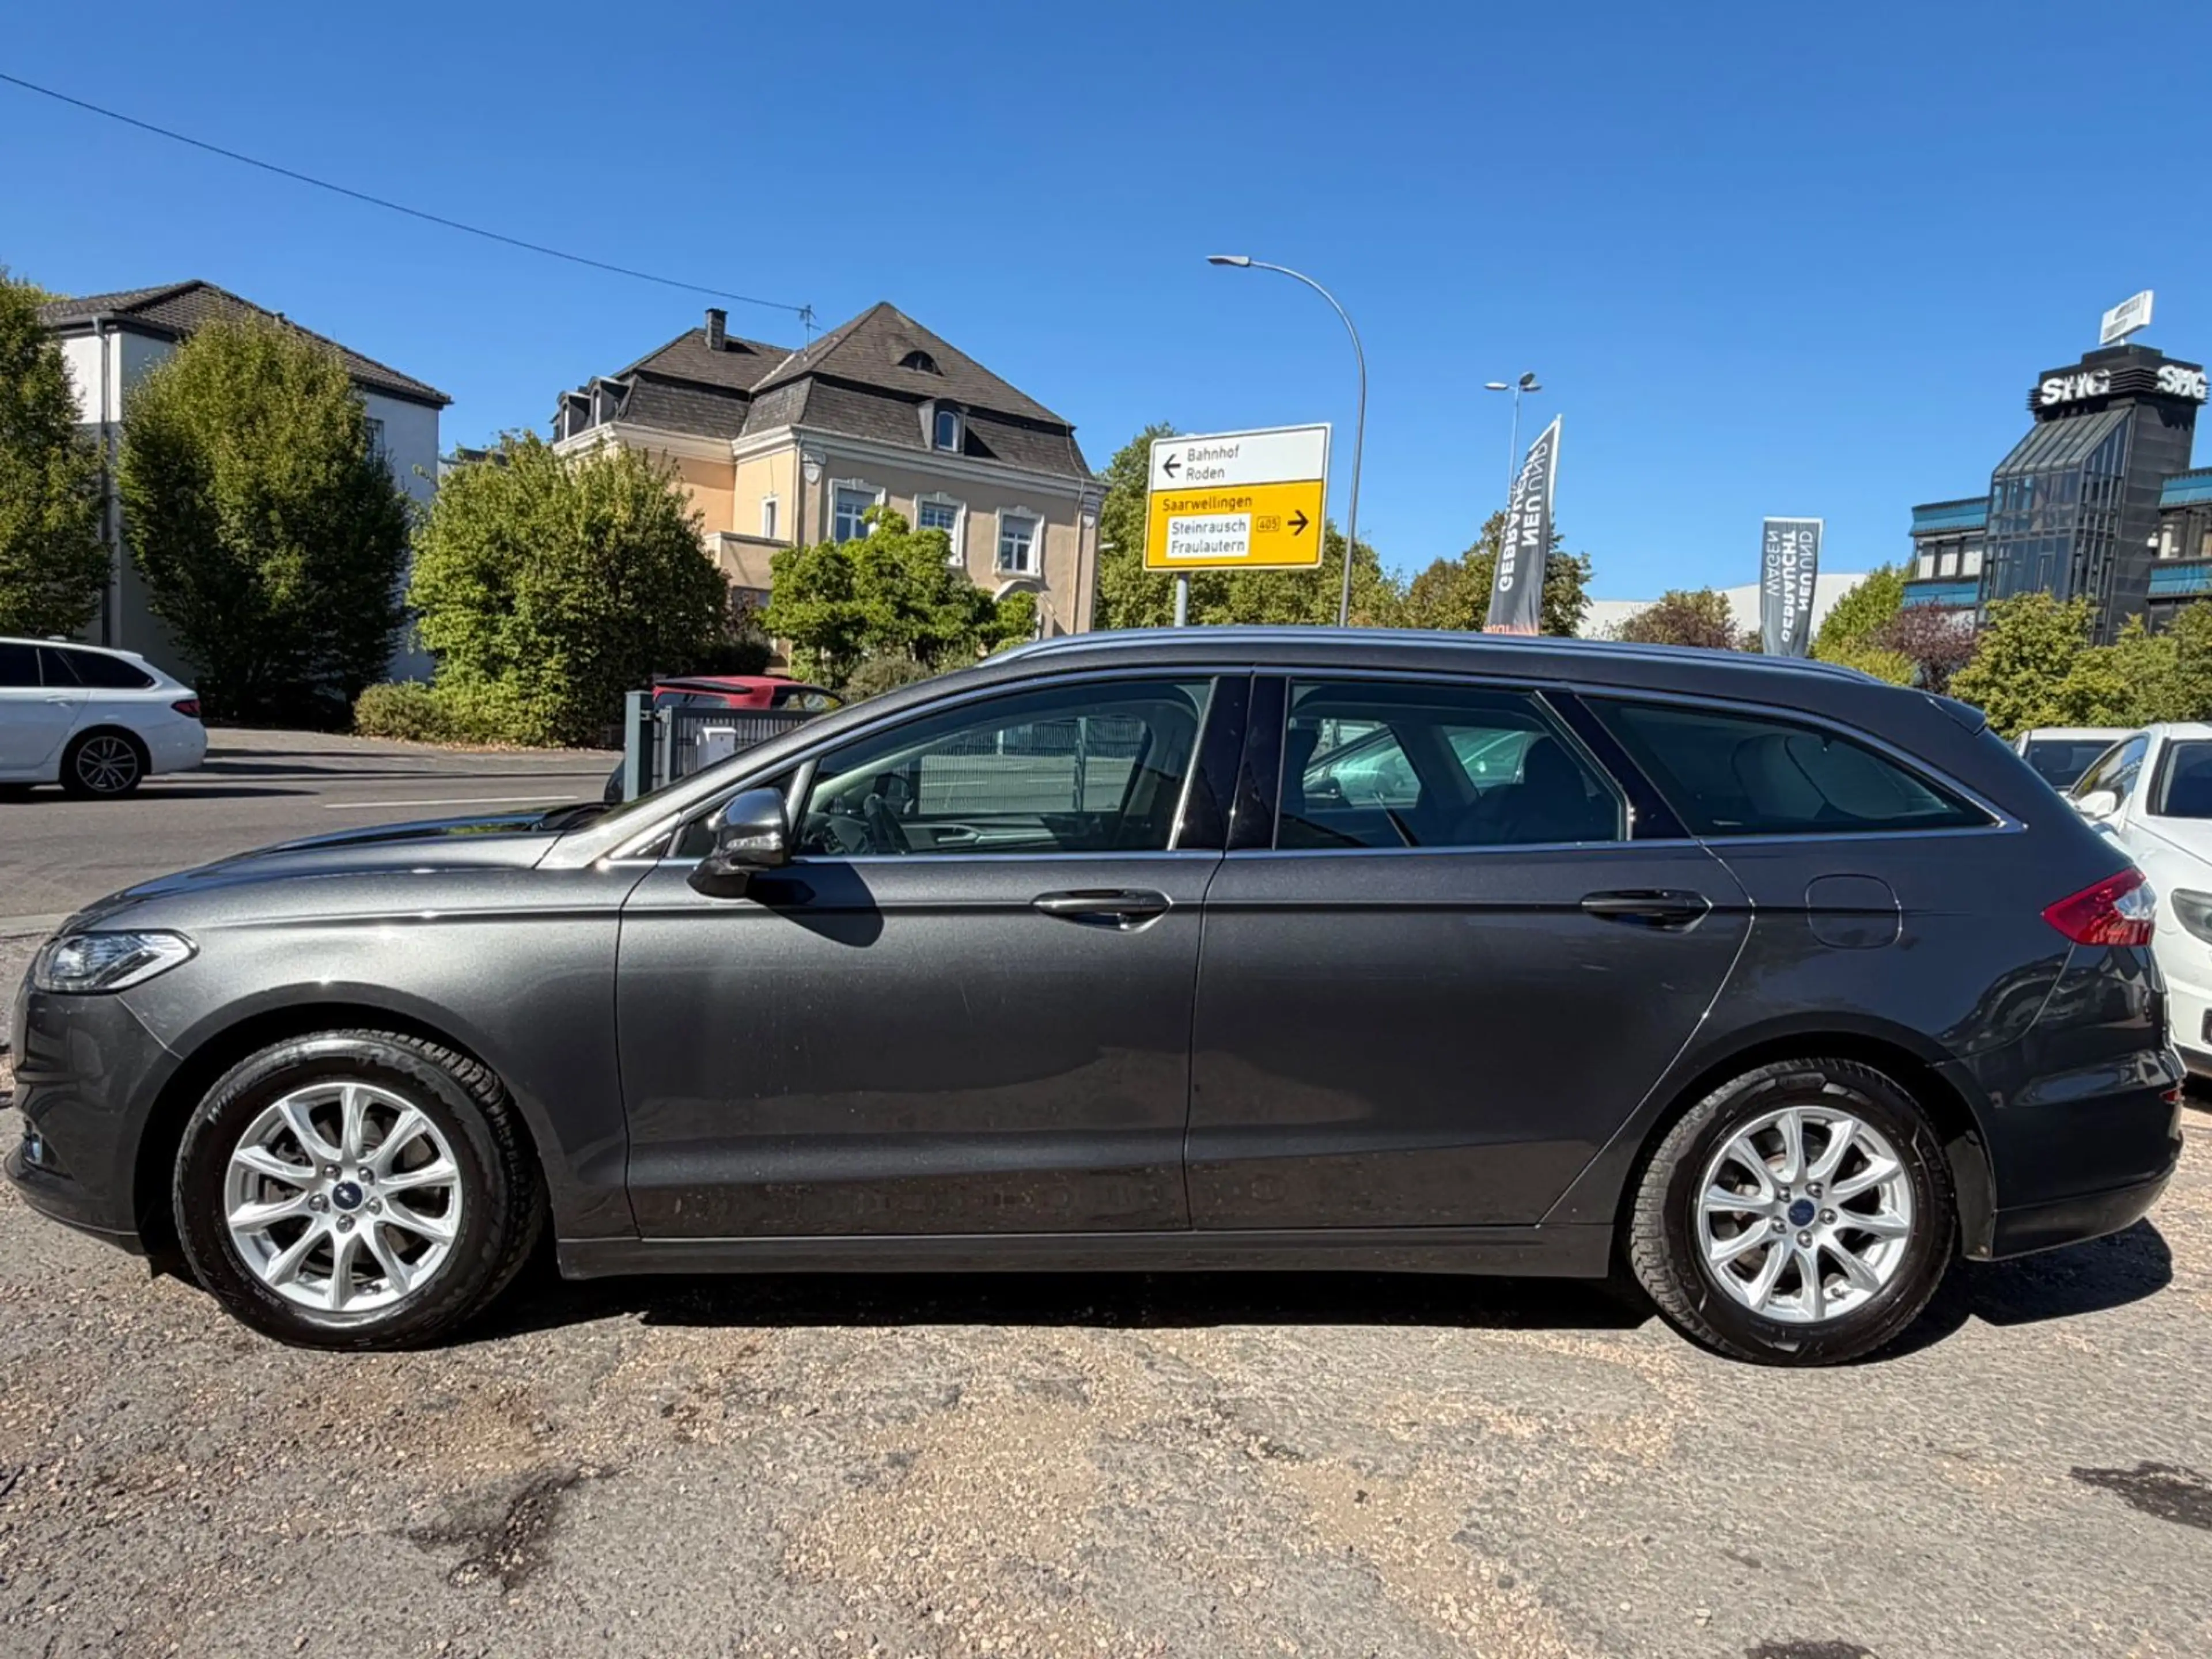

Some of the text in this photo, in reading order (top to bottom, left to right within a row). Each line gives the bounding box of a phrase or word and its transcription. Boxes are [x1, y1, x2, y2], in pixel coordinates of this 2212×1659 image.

[2040, 369, 2111, 404] SHG
[2156, 365, 2207, 399] SHG
[1187, 445, 1240, 461] Bahnhof
[1187, 467, 1225, 481] Roden
[1162, 495, 1252, 512] Saarwellingen
[1171, 519, 1247, 535] Steinrausch
[1259, 518, 1277, 529] 405
[1171, 540, 1245, 554] Fraulautern
